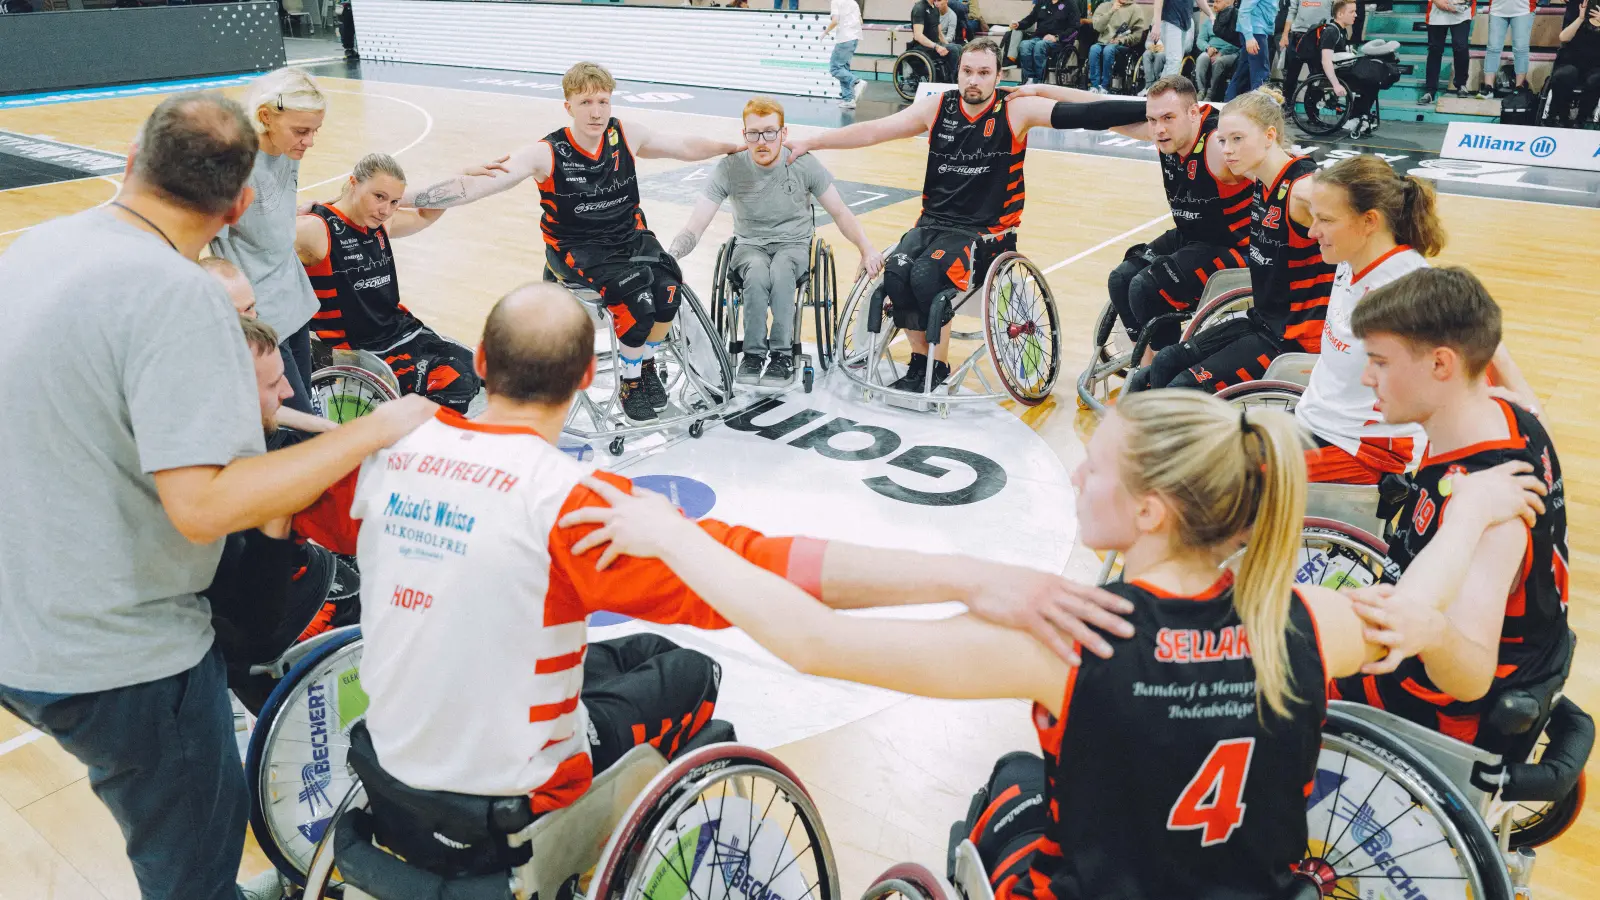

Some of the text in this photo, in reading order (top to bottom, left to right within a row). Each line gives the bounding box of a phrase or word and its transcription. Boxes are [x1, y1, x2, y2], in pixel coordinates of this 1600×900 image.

[983, 117, 996, 137] 0
[1458, 133, 1526, 152] Allianz
[611, 149, 620, 172] 7
[1186, 159, 1198, 180] 9
[1261, 204, 1282, 230] 22
[930, 249, 946, 260] 0
[667, 285, 677, 304] 7
[387, 452, 520, 493] RSV BAYREUTH
[433, 501, 476, 533] Weisse
[1411, 487, 1436, 536] 19
[384, 523, 468, 556] ALKOHOLFREI
[390, 584, 433, 614] HOPP
[307, 684, 331, 775] BECHERT
[1166, 737, 1256, 847] 4
